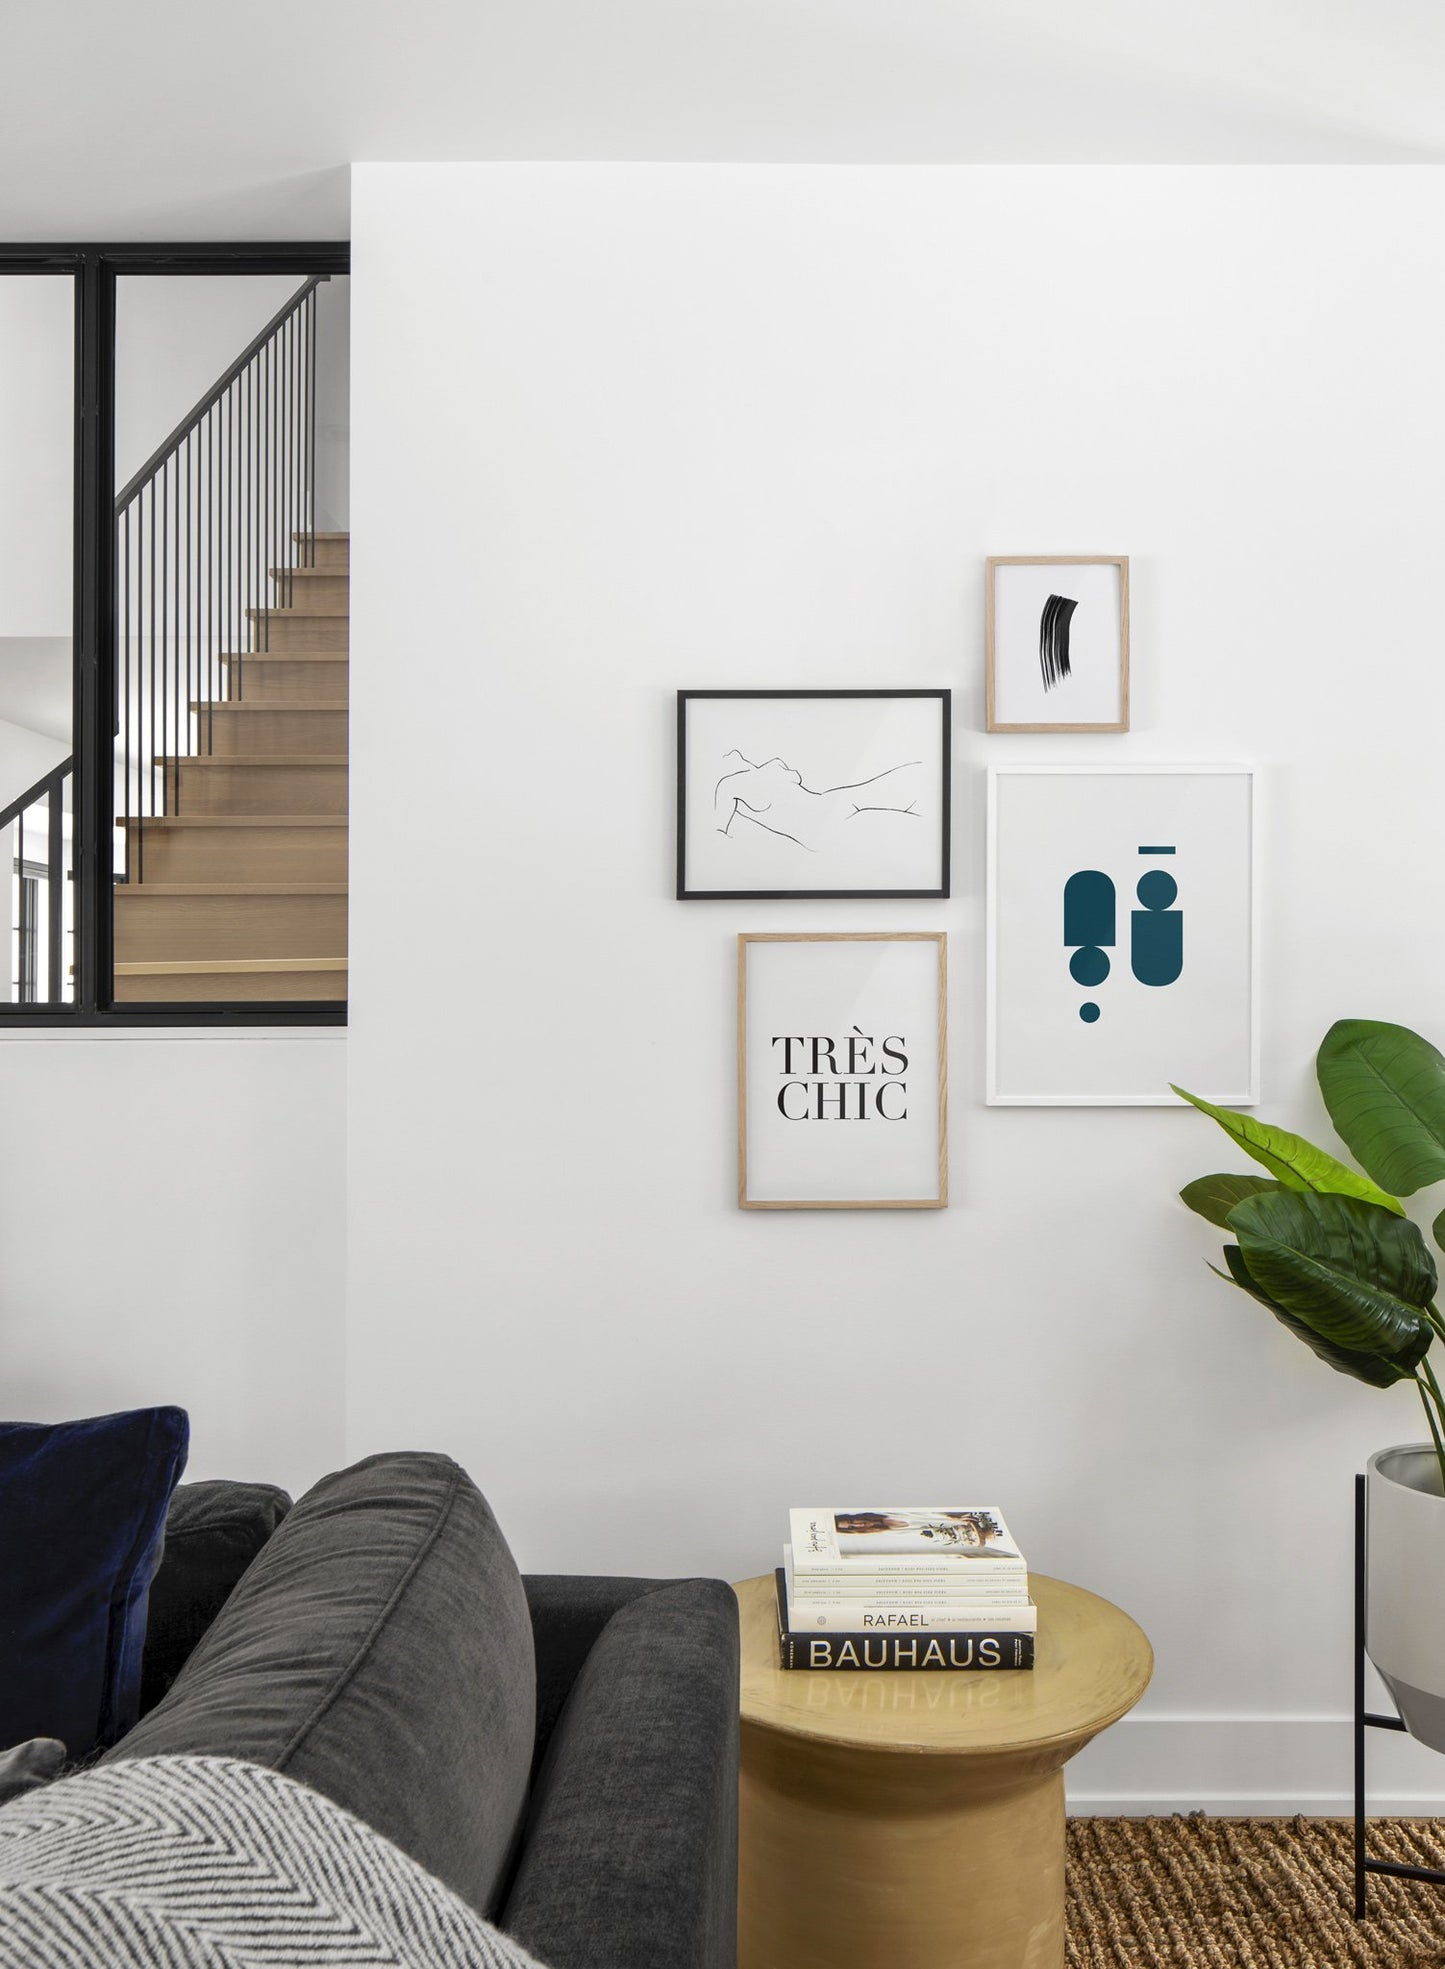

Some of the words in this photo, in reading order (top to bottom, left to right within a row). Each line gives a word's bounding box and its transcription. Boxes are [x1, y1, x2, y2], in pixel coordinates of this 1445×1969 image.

[772, 1026, 908, 1075] TRÈS
[777, 1081, 907, 1120] CHIC
[863, 1614, 929, 1626] RAFAEL
[810, 1638, 1001, 1667] BAUHAUS
